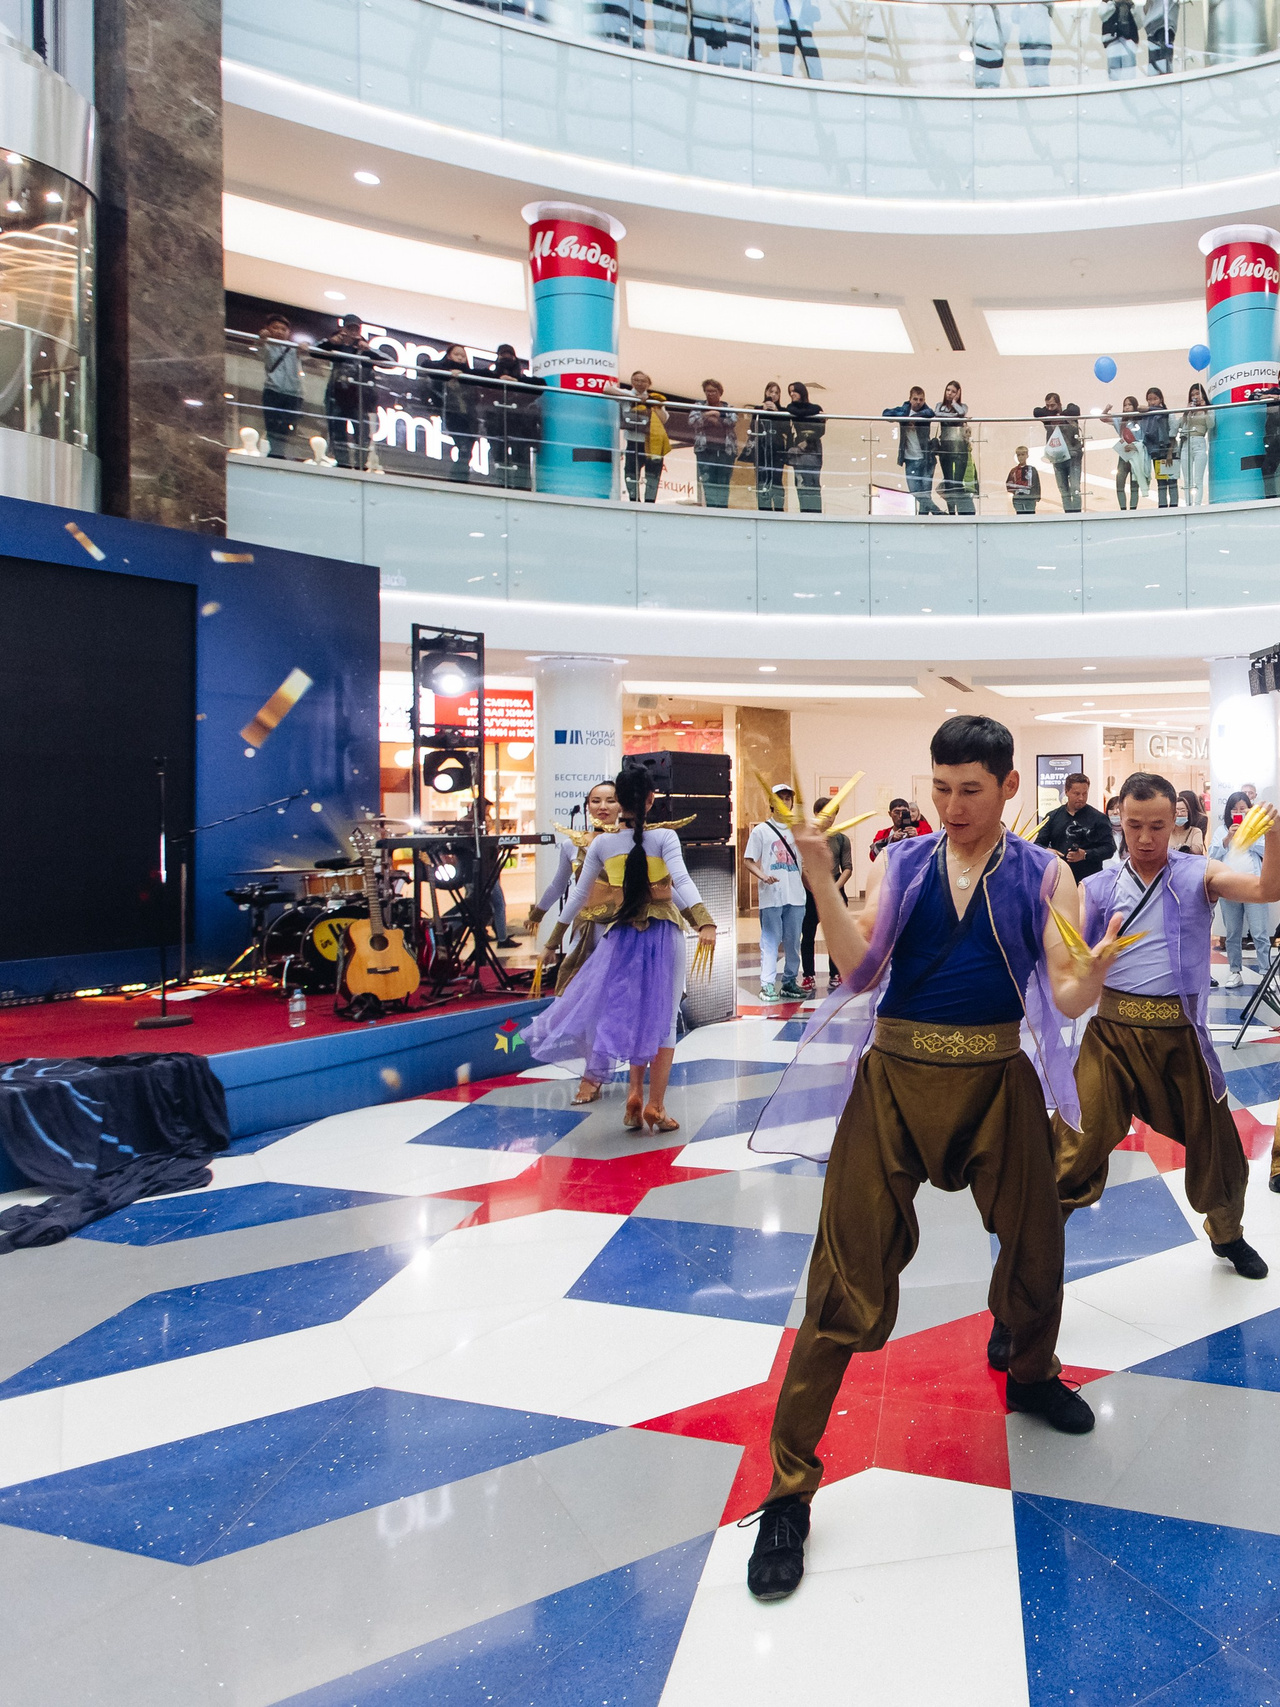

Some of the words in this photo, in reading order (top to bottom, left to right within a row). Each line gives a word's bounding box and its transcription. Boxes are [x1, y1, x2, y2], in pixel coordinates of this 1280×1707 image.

[1207, 253, 1280, 288] М.видео
[575, 377, 585, 388] 3
[1244, 389, 1251, 399] 3
[458, 706, 505, 718] БЫТВАЯ
[585, 730, 615, 739] ЧИТАЙ
[585, 738, 616, 747] ГОРОД
[554, 791, 589, 799] НОВИН
